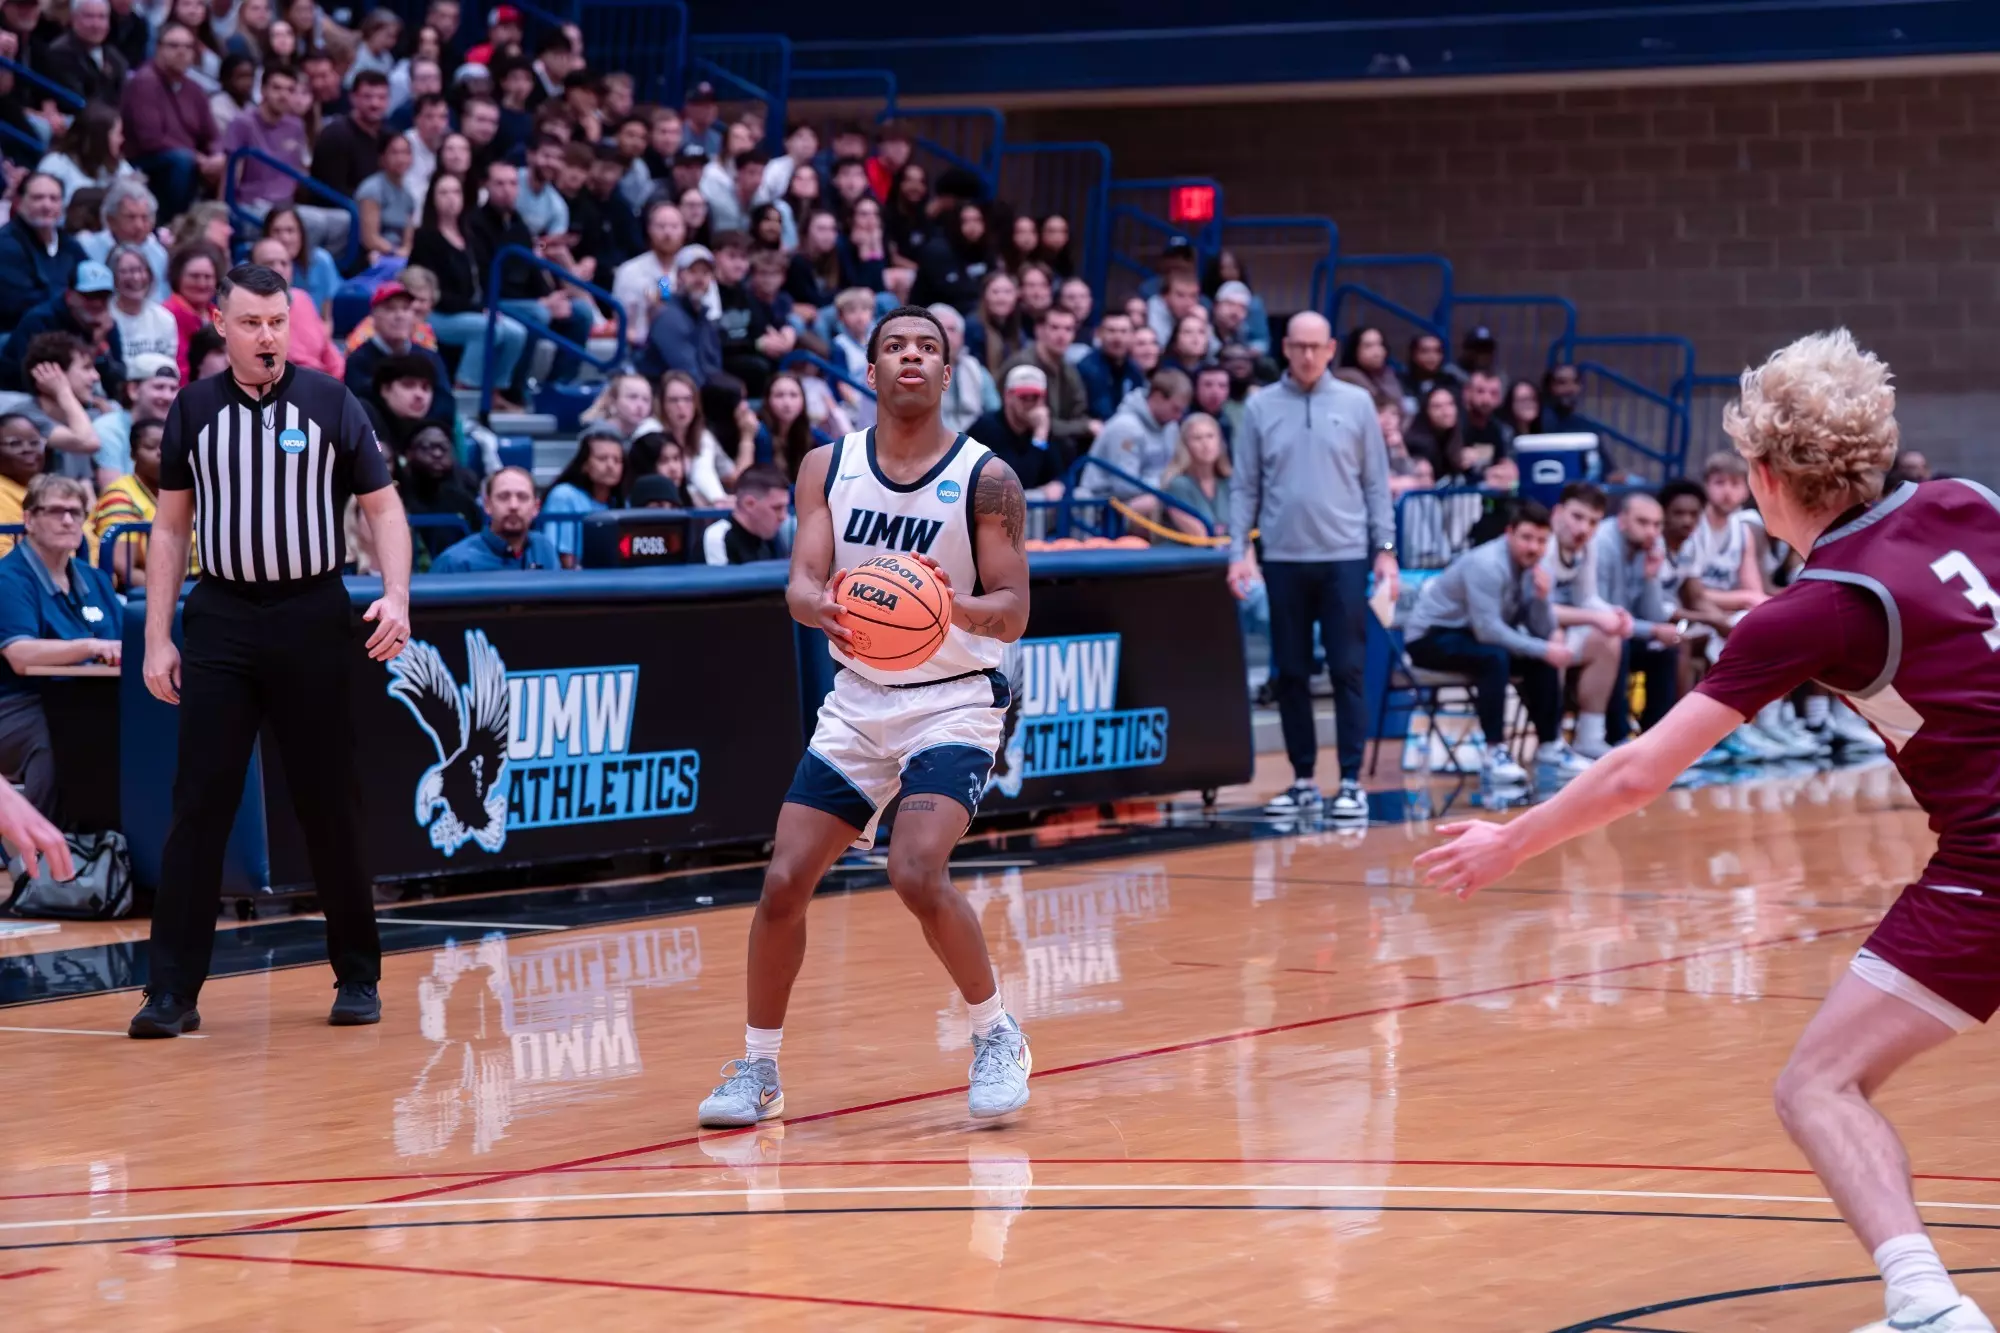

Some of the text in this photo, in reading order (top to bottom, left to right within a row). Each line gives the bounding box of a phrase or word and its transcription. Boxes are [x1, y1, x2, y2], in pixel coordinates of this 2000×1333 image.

[283, 439, 305, 448] NCAA
[939, 489, 960, 498] NCAA
[843, 507, 945, 555] UMW
[847, 582, 898, 611] NCAA
[1022, 639, 1118, 717] UMW
[507, 670, 635, 761] UMW
[1023, 713, 1166, 772] ATHLETICS
[506, 754, 697, 825] ATHLETICS
